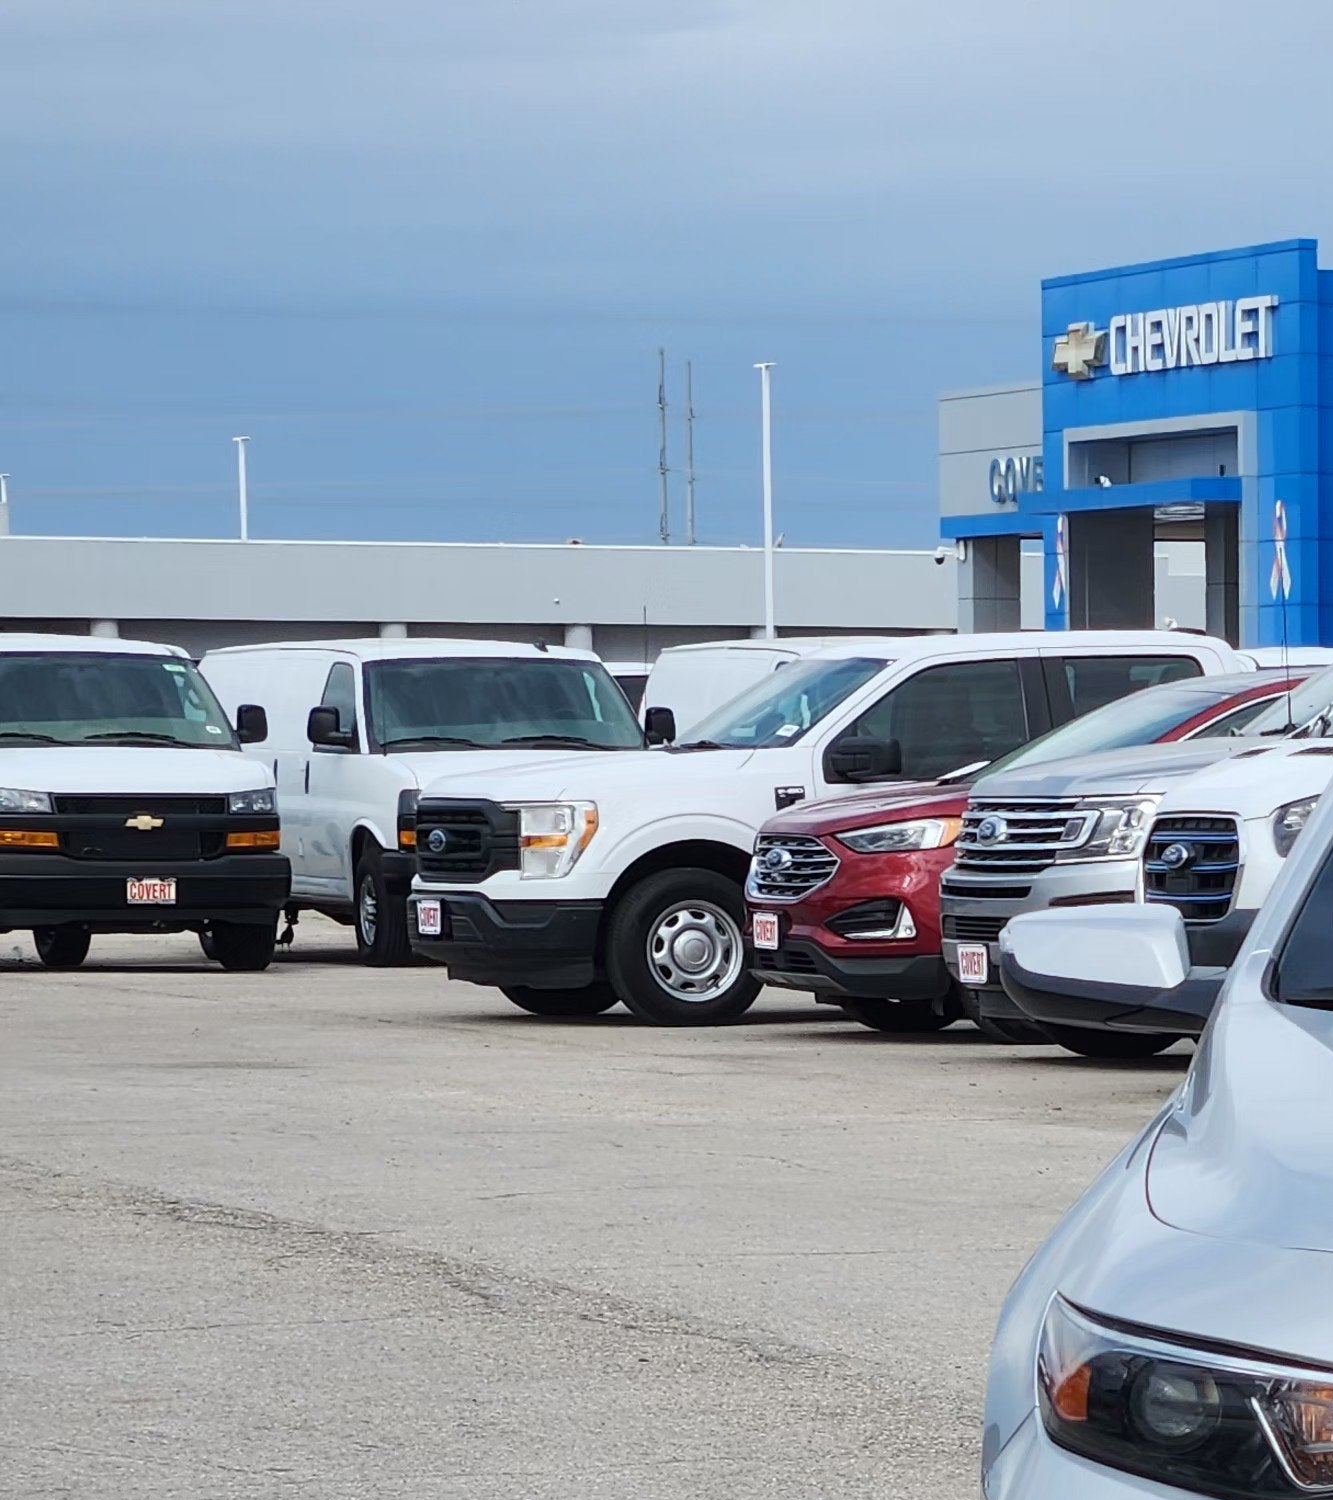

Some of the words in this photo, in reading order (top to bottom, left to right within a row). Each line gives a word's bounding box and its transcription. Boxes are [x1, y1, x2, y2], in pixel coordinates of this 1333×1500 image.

[1110, 295, 1279, 375] CHEVROLET
[130, 883, 173, 899] COVERT
[961, 951, 984, 975] COVERT
